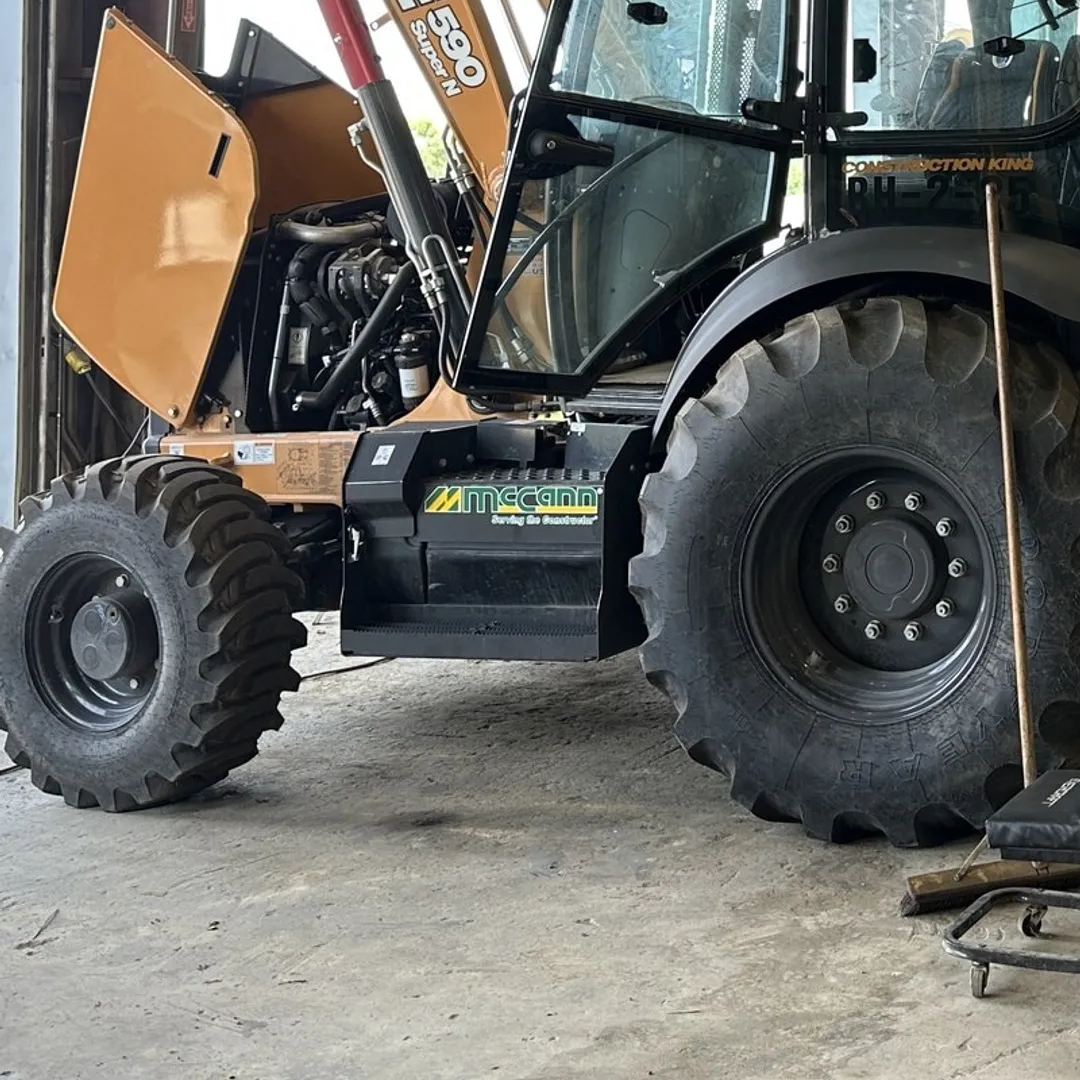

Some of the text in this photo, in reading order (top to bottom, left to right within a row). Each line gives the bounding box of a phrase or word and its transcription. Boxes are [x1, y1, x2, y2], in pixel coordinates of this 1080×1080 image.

[410, 17, 463, 98] Super N
[426, 4, 487, 88] 590
[842, 157, 1035, 174] CONSTRUCTION KING
